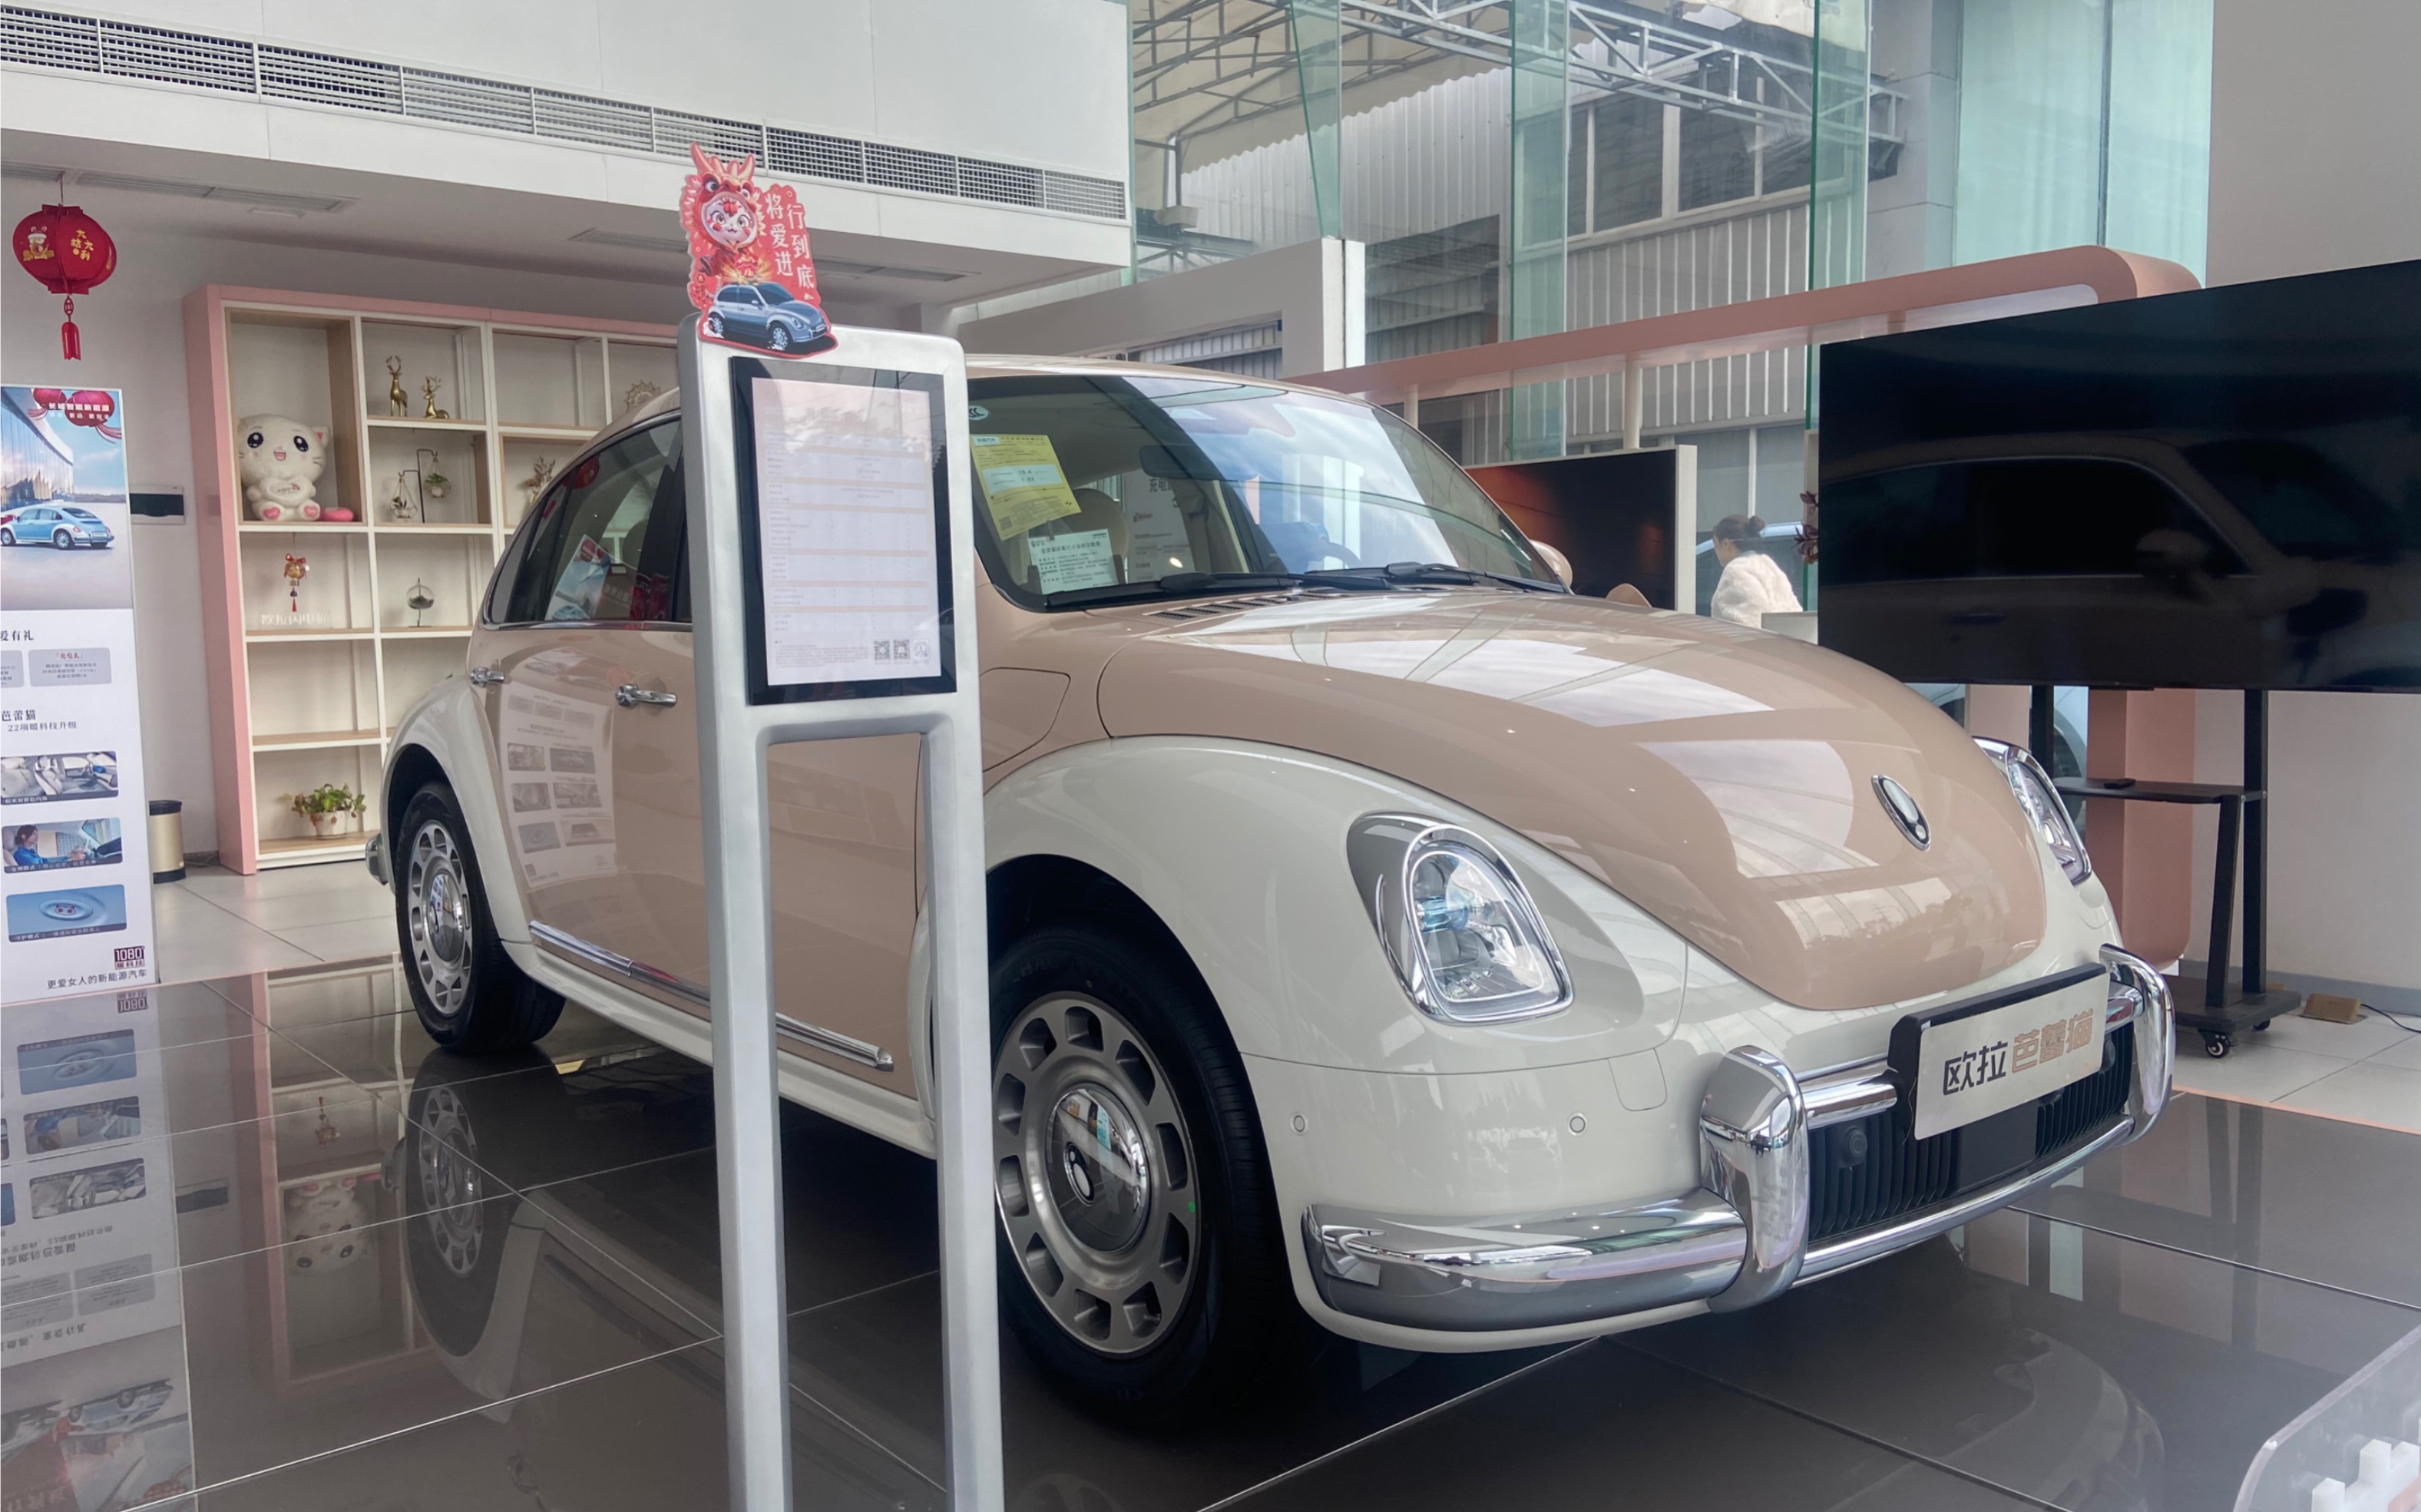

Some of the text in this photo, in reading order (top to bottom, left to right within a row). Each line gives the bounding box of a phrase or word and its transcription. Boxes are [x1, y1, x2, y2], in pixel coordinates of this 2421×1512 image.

[47, 969, 147, 989] 更爱女人的新能源汽车
